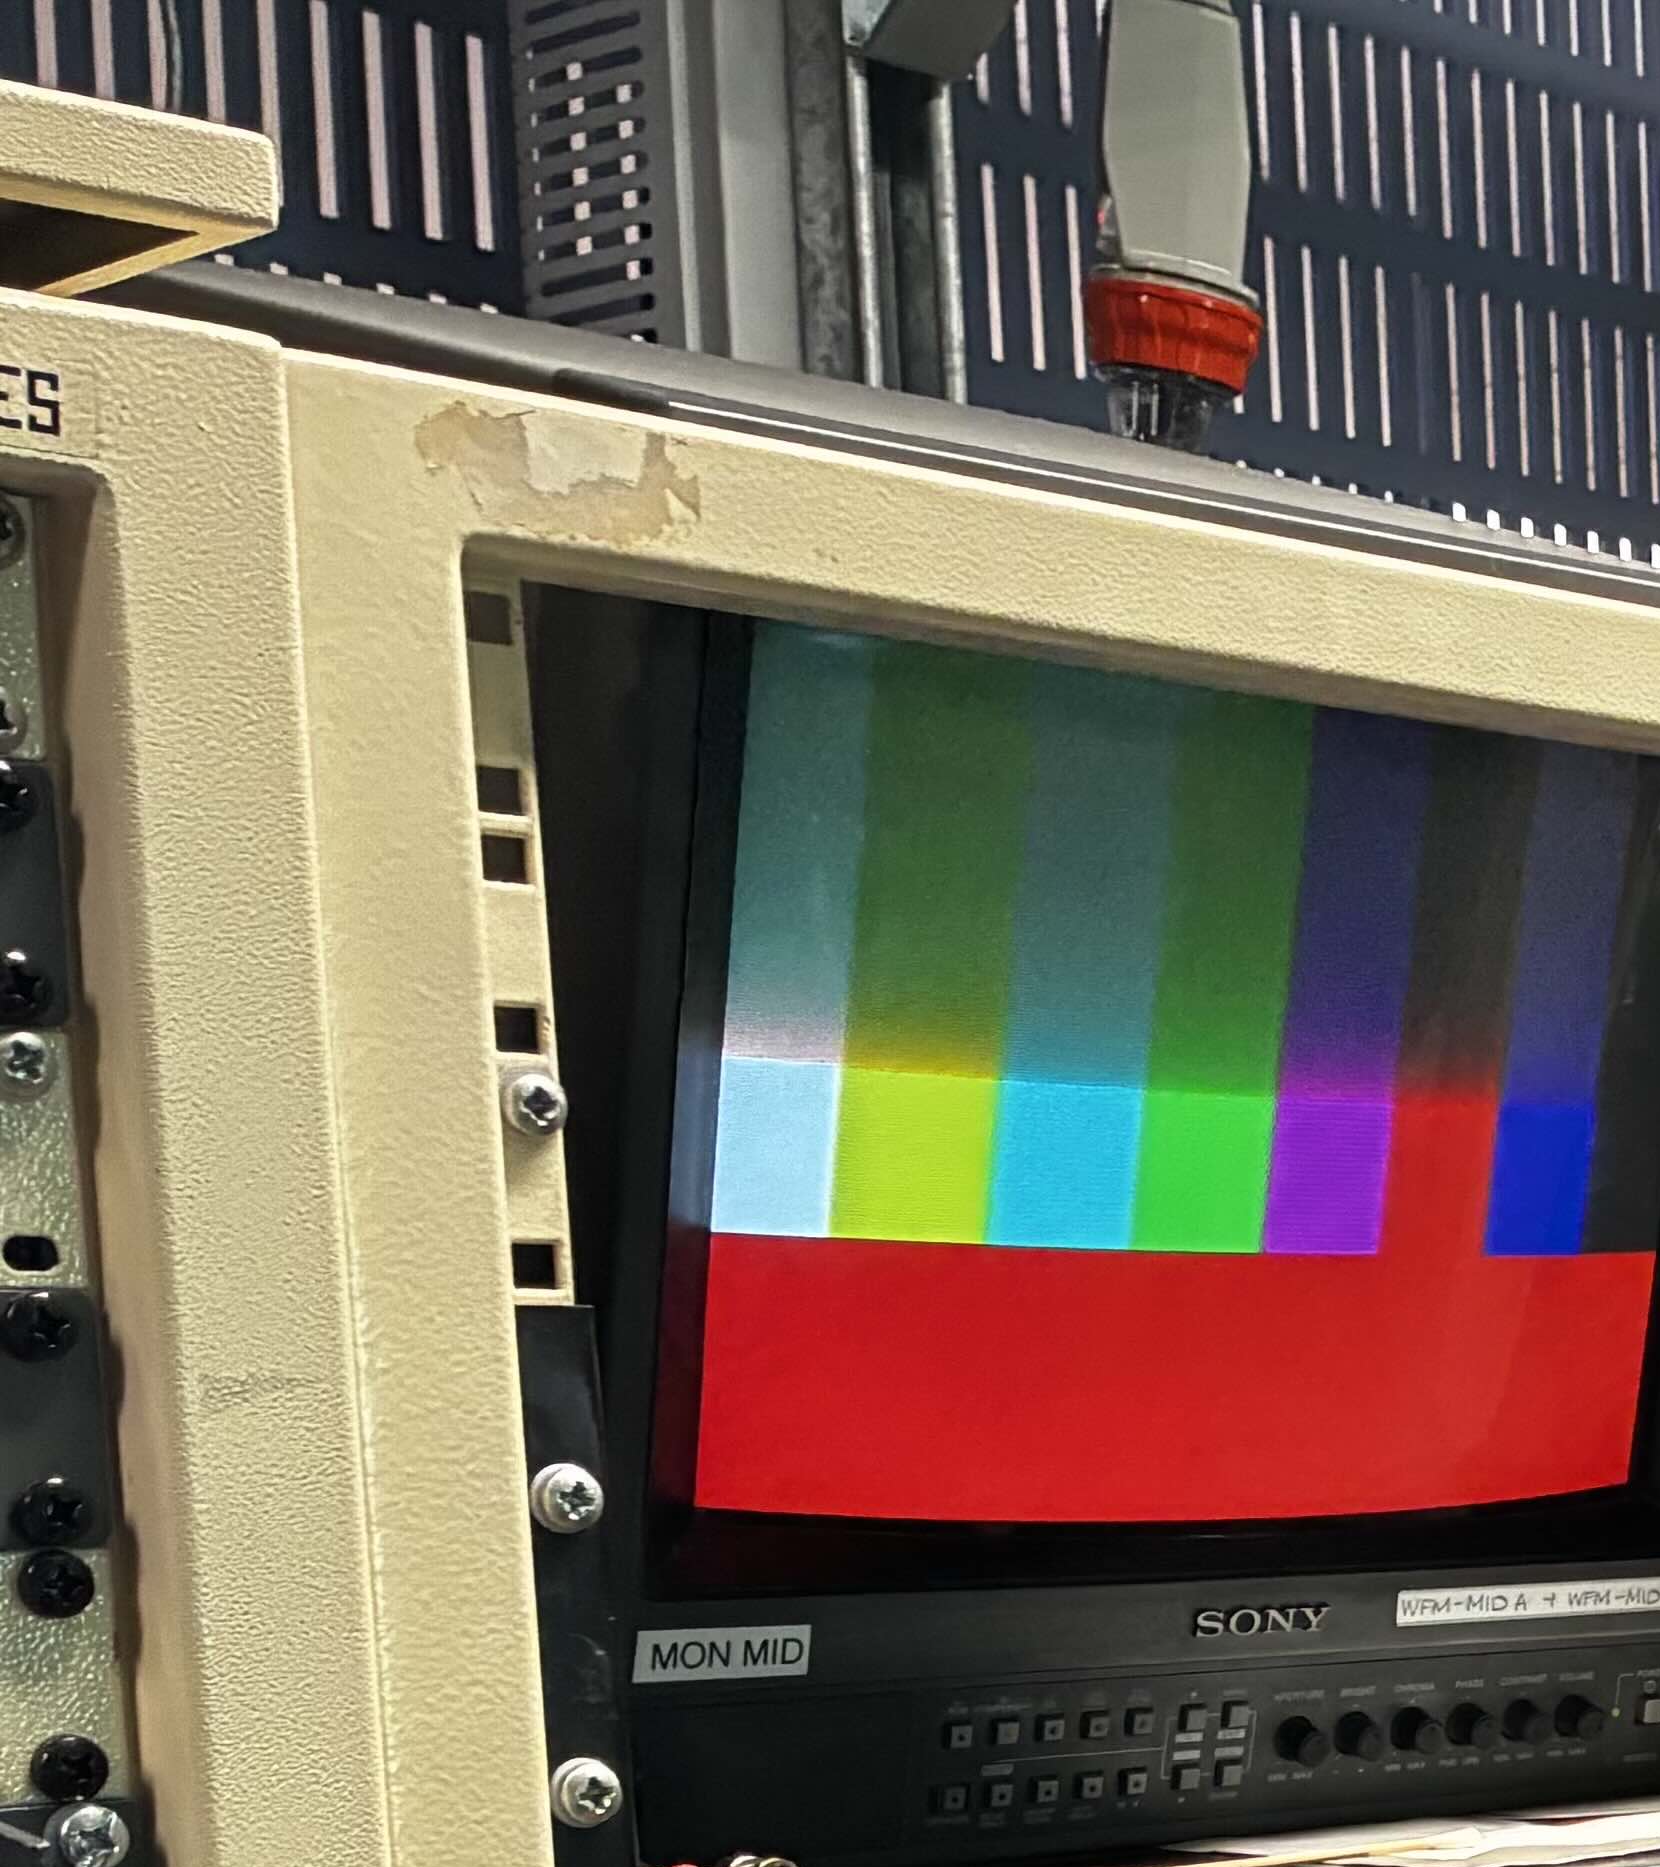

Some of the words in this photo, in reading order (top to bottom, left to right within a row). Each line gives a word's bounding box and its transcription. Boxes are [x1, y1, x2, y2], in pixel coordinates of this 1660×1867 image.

[1515, 1593, 1528, 1612] A
[1195, 1605, 1331, 1638] SONY
[650, 1640, 732, 1671] MON
[742, 1637, 804, 1667] MID
